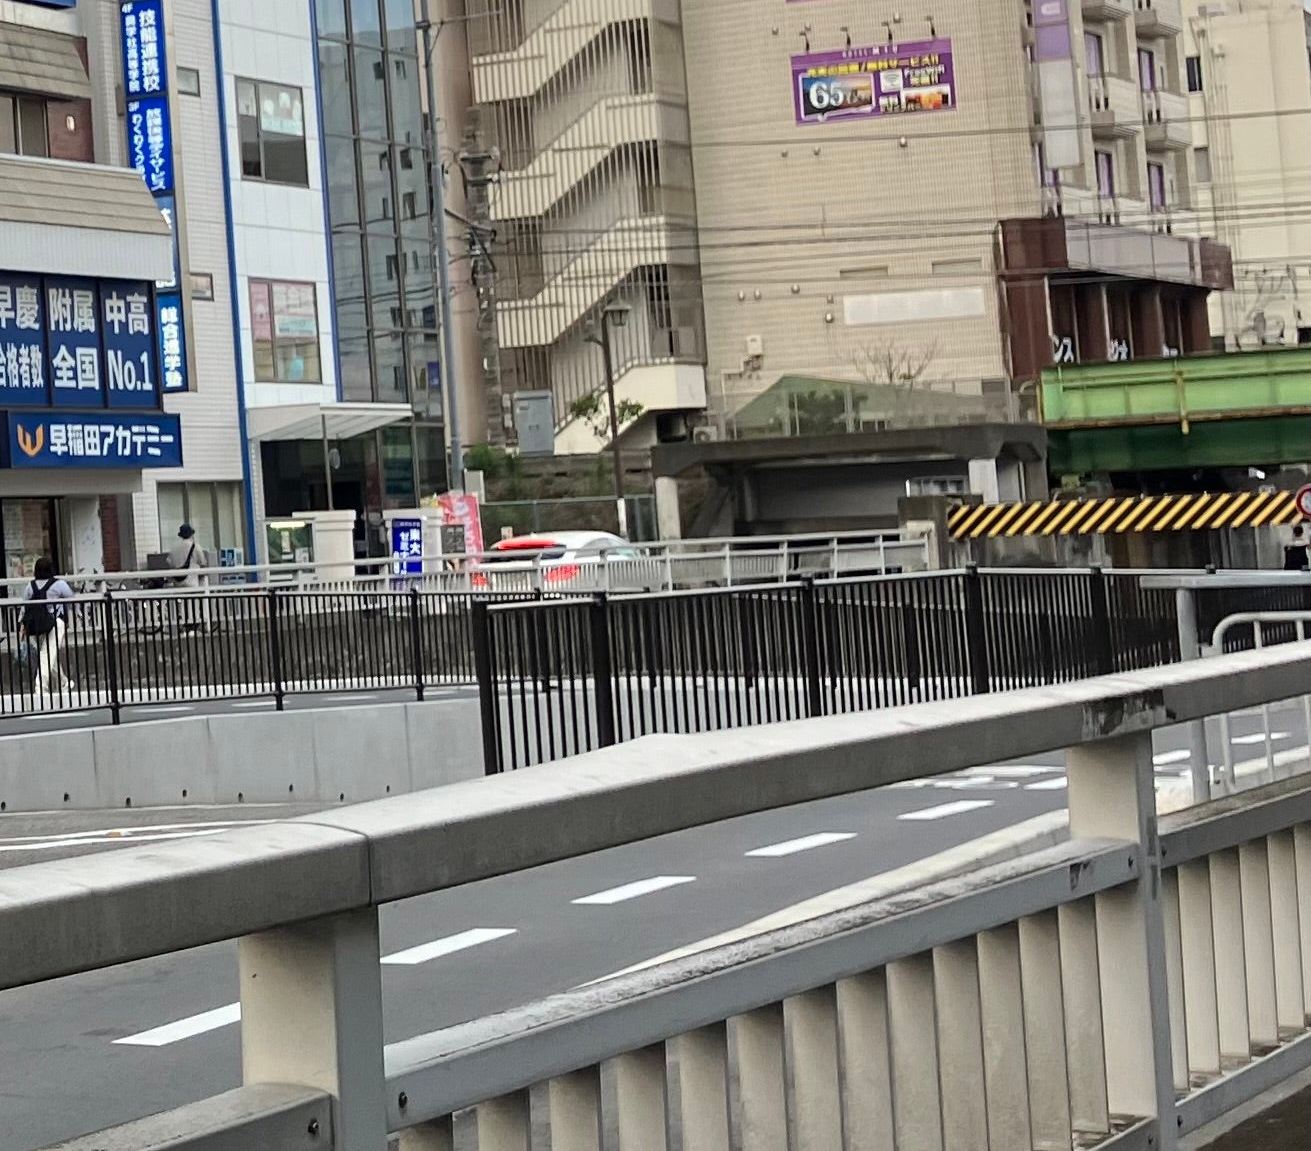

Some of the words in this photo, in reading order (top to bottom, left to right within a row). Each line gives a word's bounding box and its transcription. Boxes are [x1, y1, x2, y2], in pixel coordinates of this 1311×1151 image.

[49, 422, 175, 457] 早稲田アカデミー
